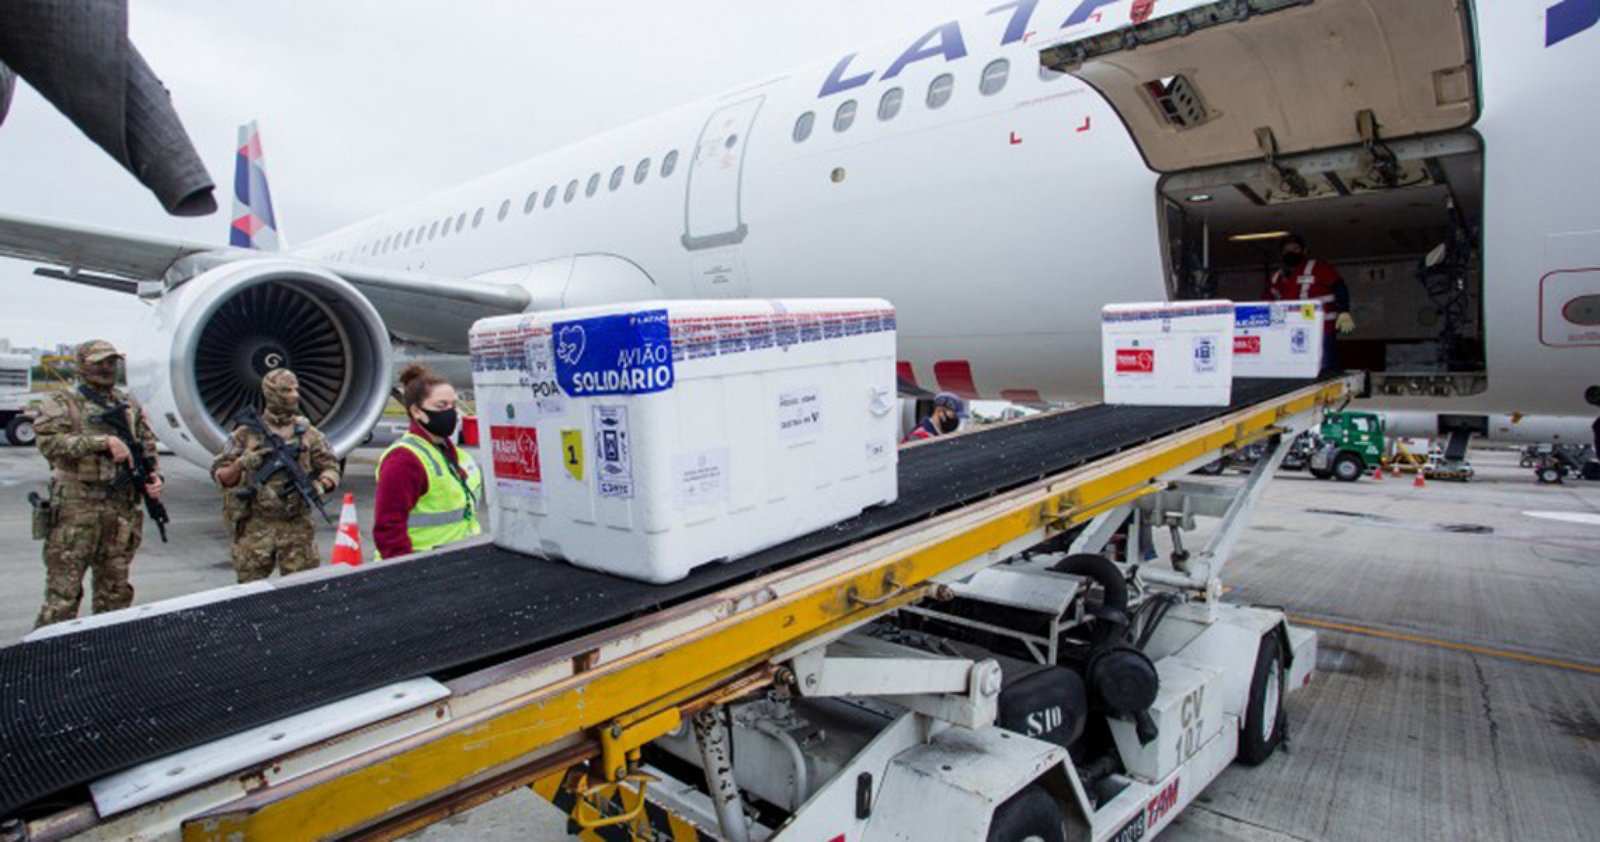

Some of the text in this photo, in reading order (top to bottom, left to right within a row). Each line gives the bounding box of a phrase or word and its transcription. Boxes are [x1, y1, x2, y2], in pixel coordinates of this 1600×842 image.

[617, 343, 668, 367] AVIÃO
[531, 379, 560, 398] POA
[572, 364, 671, 393] SOLIDÁRIO
[567, 444, 579, 465] 1
[1027, 705, 1062, 738] S10
[1181, 684, 1205, 730] CV
[1147, 775, 1180, 830] TAM
